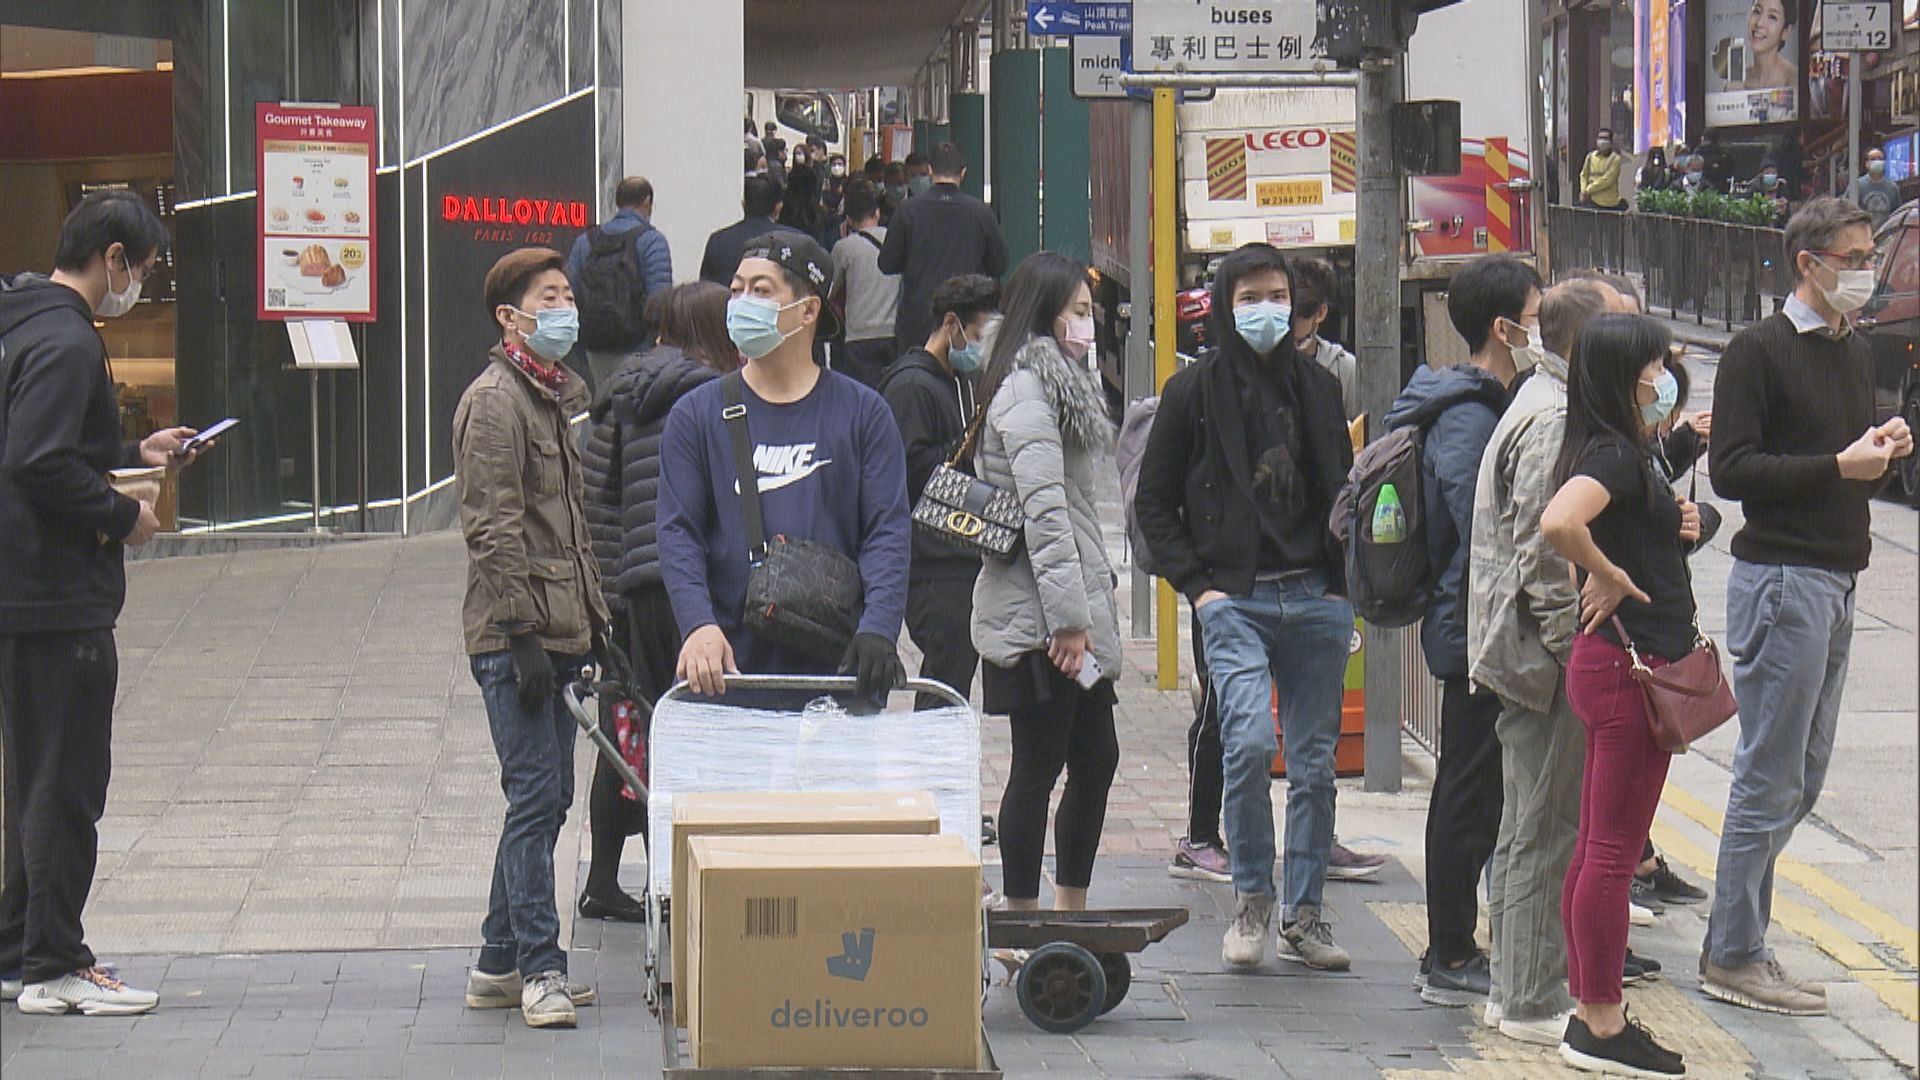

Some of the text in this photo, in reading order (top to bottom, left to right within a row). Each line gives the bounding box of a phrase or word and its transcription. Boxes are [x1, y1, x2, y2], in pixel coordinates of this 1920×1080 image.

[1211, 6, 1272, 23] buses
[1865, 6, 1877, 21] 7
[1084, 20, 1107, 31] Peak
[1866, 30, 1887, 46] 12
[265, 112, 367, 130] Gourmet Takeaway
[1245, 128, 1326, 151] LEEO
[442, 194, 588, 228] DALLOYAU
[473, 228, 515, 241] PARIS
[753, 442, 817, 475] NIKE
[770, 998, 929, 1029] deliveroo
